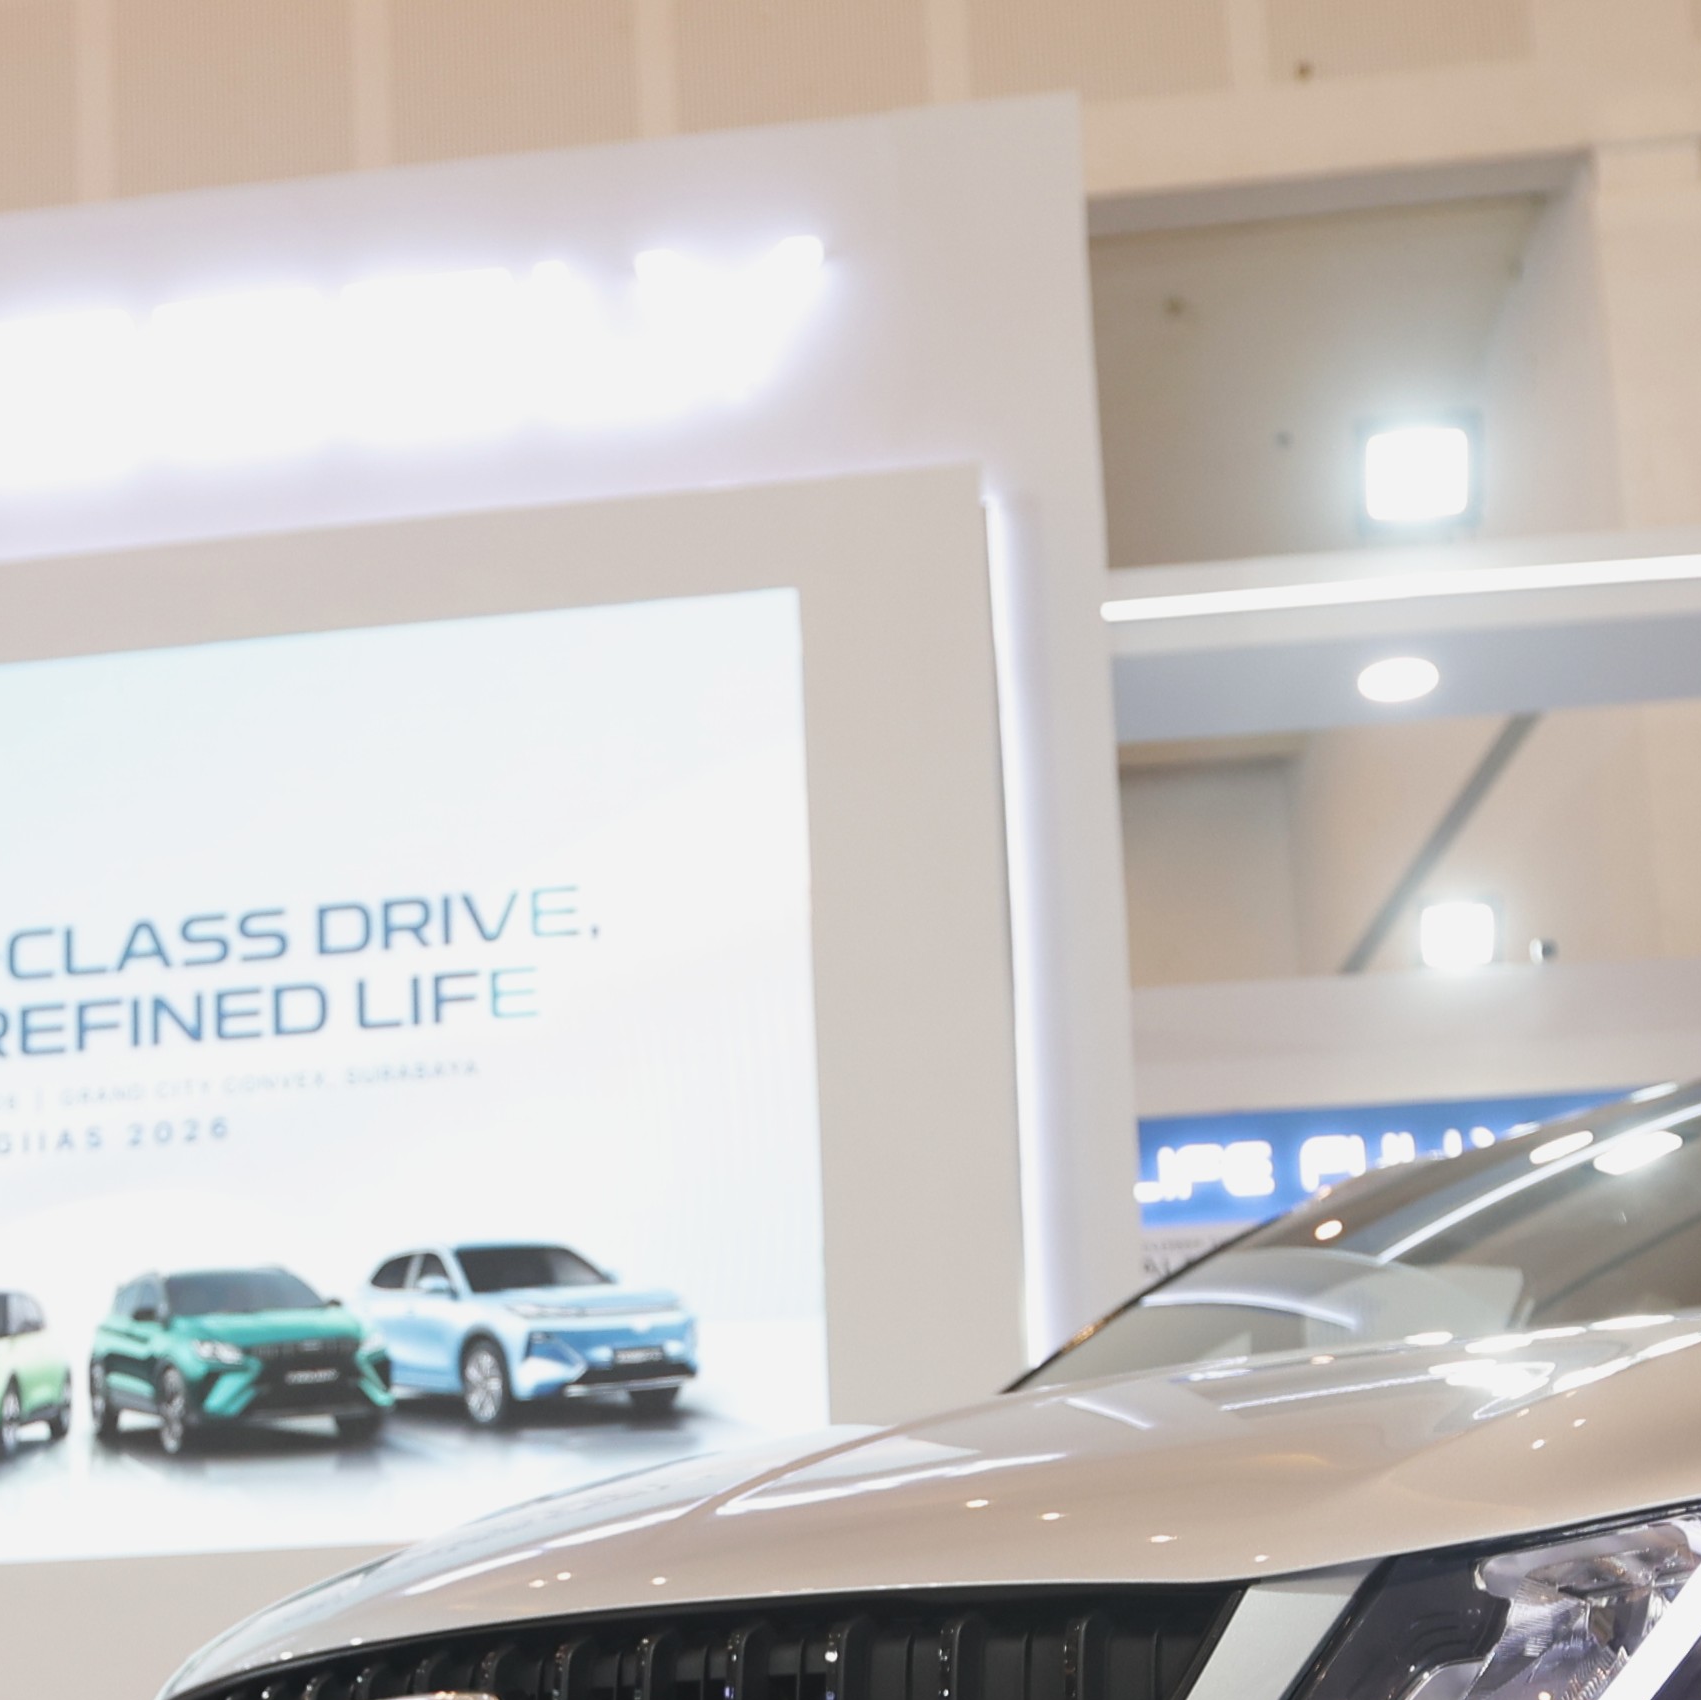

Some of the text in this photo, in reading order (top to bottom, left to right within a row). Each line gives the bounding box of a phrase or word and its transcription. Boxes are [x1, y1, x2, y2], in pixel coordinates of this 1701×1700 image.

[314, 884, 599, 958] DRIVE,
[354, 966, 539, 1031] LIFE
[127, 1114, 230, 1151] 2026
